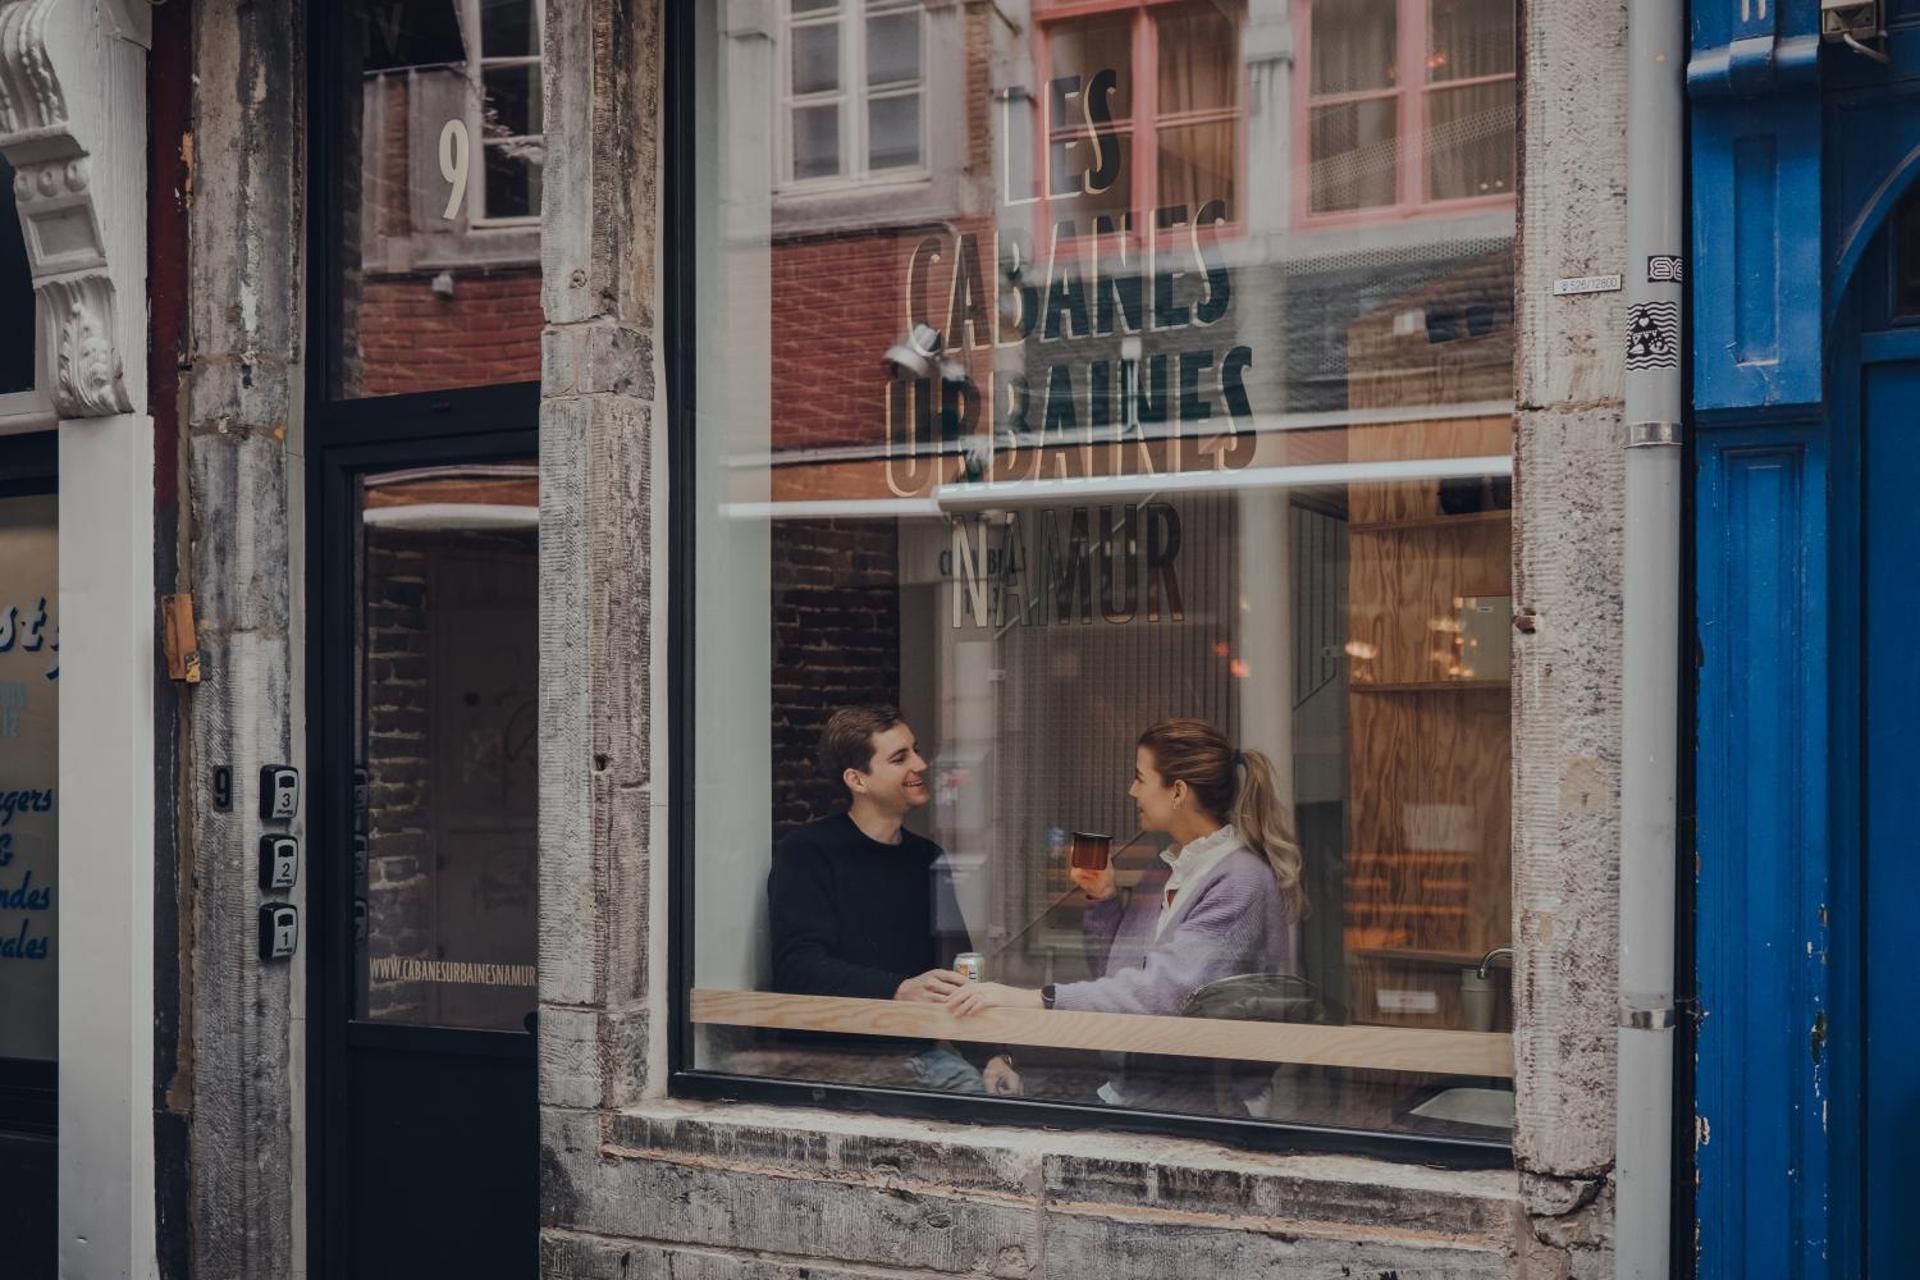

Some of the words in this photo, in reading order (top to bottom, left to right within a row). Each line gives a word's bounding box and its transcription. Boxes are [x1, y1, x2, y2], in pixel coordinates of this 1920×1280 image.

[439, 119, 469, 219] 9
[1003, 68, 1121, 207] LES
[905, 199, 1230, 357] CABANES
[885, 345, 1257, 497] URBAINES
[950, 502, 1185, 629] NAMUR
[0, 788, 52, 827] gers
[281, 793, 290, 807] 3
[281, 863, 290, 878] 2
[0, 918, 49, 960] ales
[281, 932, 289, 946] 1
